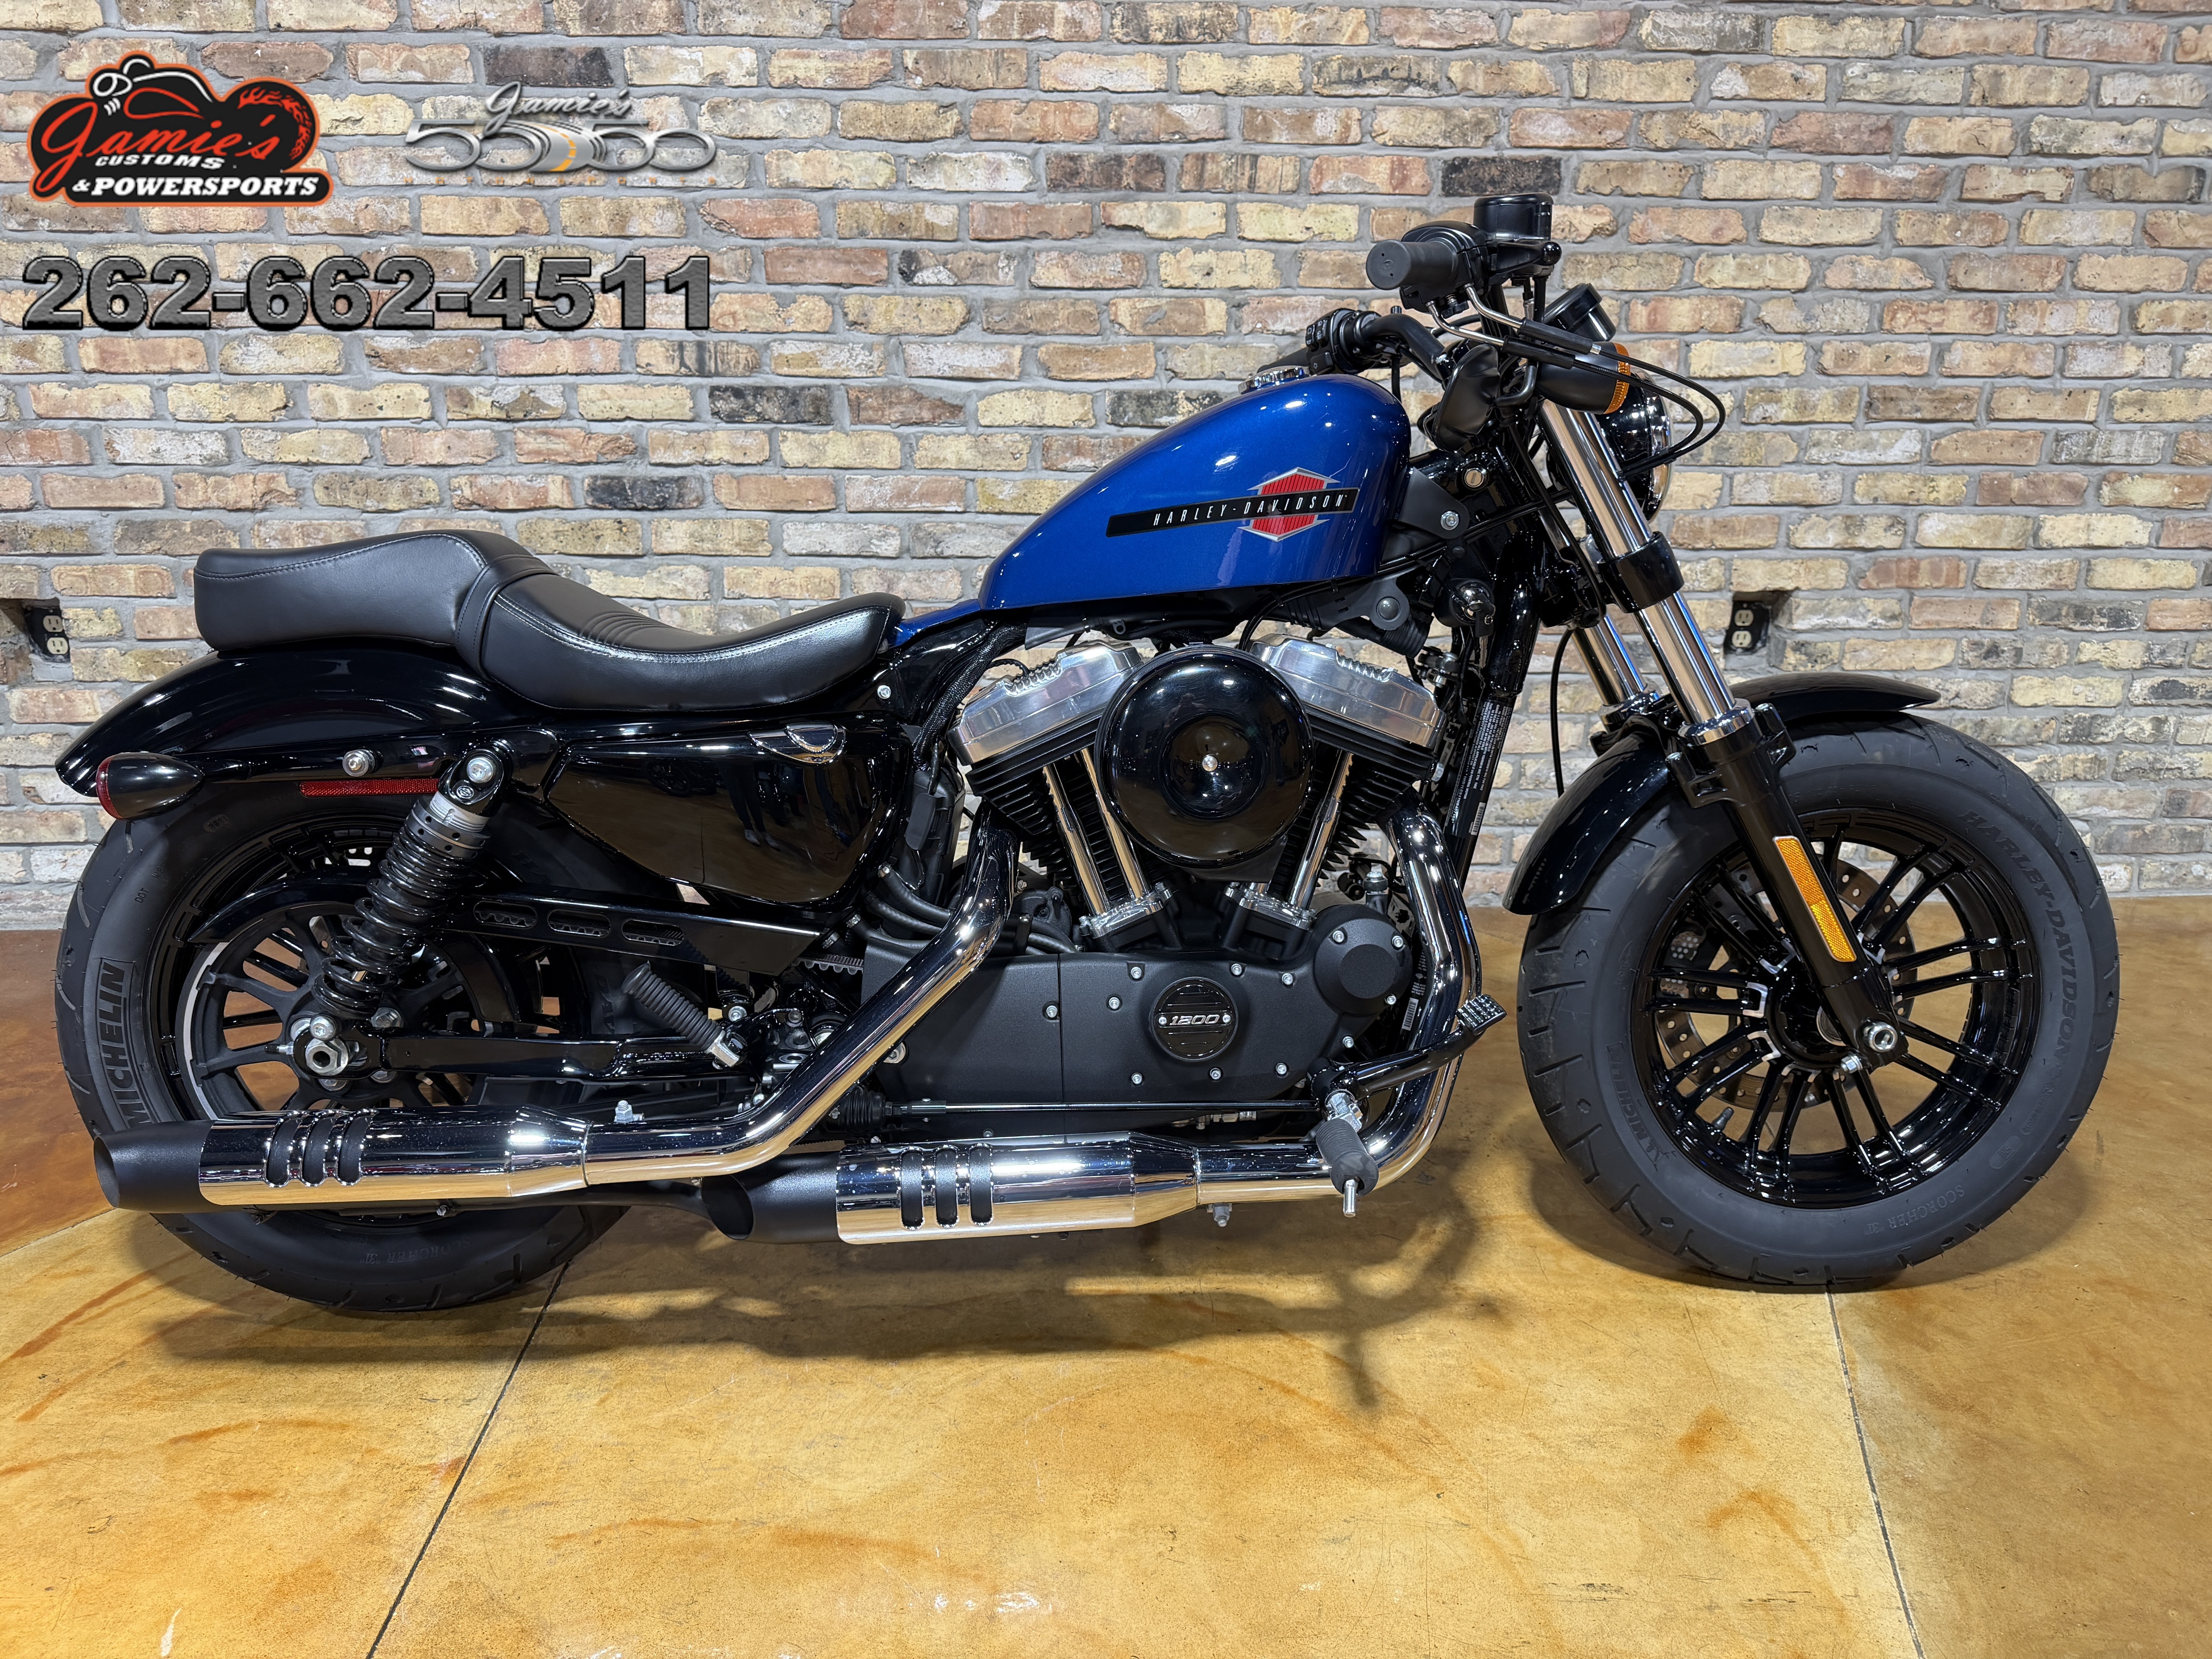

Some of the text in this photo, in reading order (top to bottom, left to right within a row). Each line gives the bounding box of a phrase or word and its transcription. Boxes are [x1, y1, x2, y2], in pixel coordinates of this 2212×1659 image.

[134, 886, 149, 905] DOT
[1959, 810, 2078, 1064] HARLEY-DAVIDSON
[99, 961, 153, 1123] MICHELIN
[1169, 1014, 1220, 1026] 1200
[1889, 1184, 1965, 1230] SCORCHER
